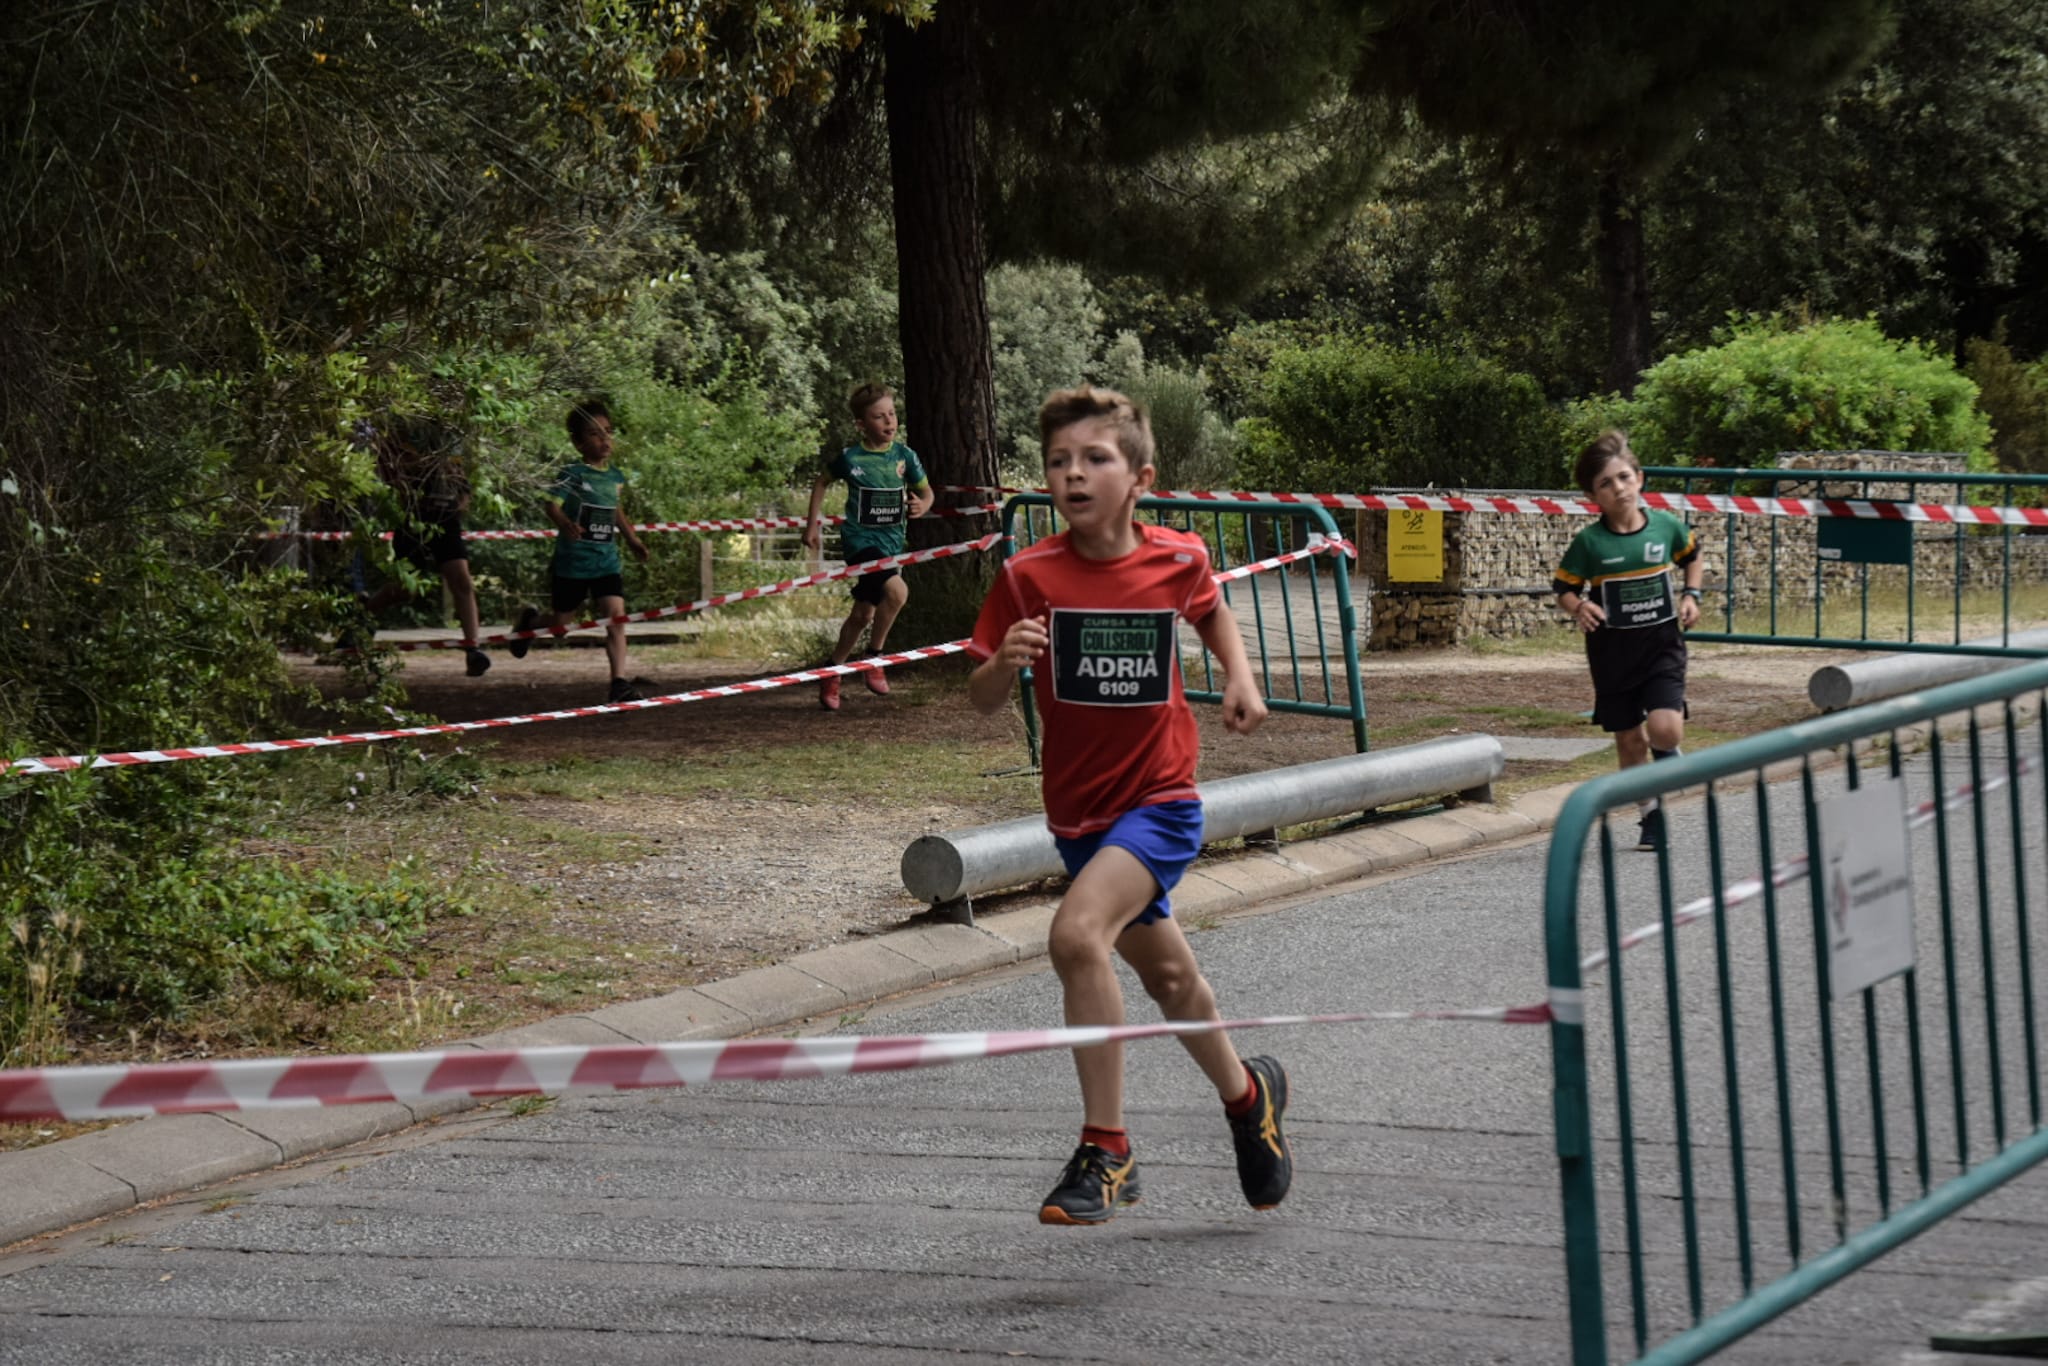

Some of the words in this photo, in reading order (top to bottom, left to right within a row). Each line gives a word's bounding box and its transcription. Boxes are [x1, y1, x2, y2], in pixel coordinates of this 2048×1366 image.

[1083, 618, 1126, 627] CURSA
[1131, 618, 1156, 627] PER
[1083, 630, 1155, 652] COLLSEROLA
[1076, 650, 1159, 679] ADRIÀ
[1098, 681, 1140, 696] 6109
